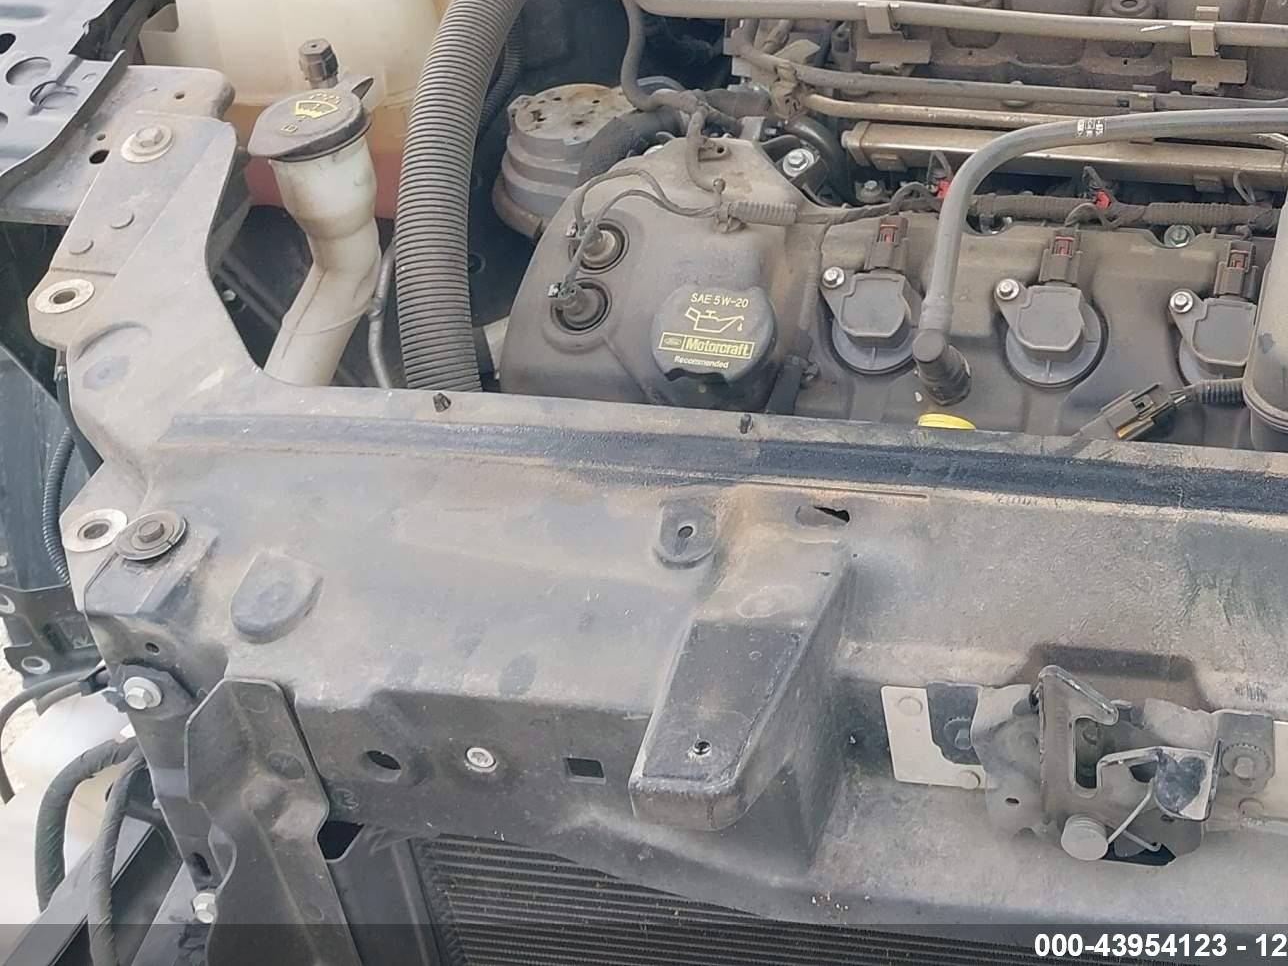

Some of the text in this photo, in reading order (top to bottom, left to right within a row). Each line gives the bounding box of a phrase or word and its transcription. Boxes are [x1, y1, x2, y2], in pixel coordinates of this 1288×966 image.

[690, 293, 749, 308] SAE 5W-20
[685, 337, 750, 356] Motorcraft
[674, 355, 729, 368] Recommended
